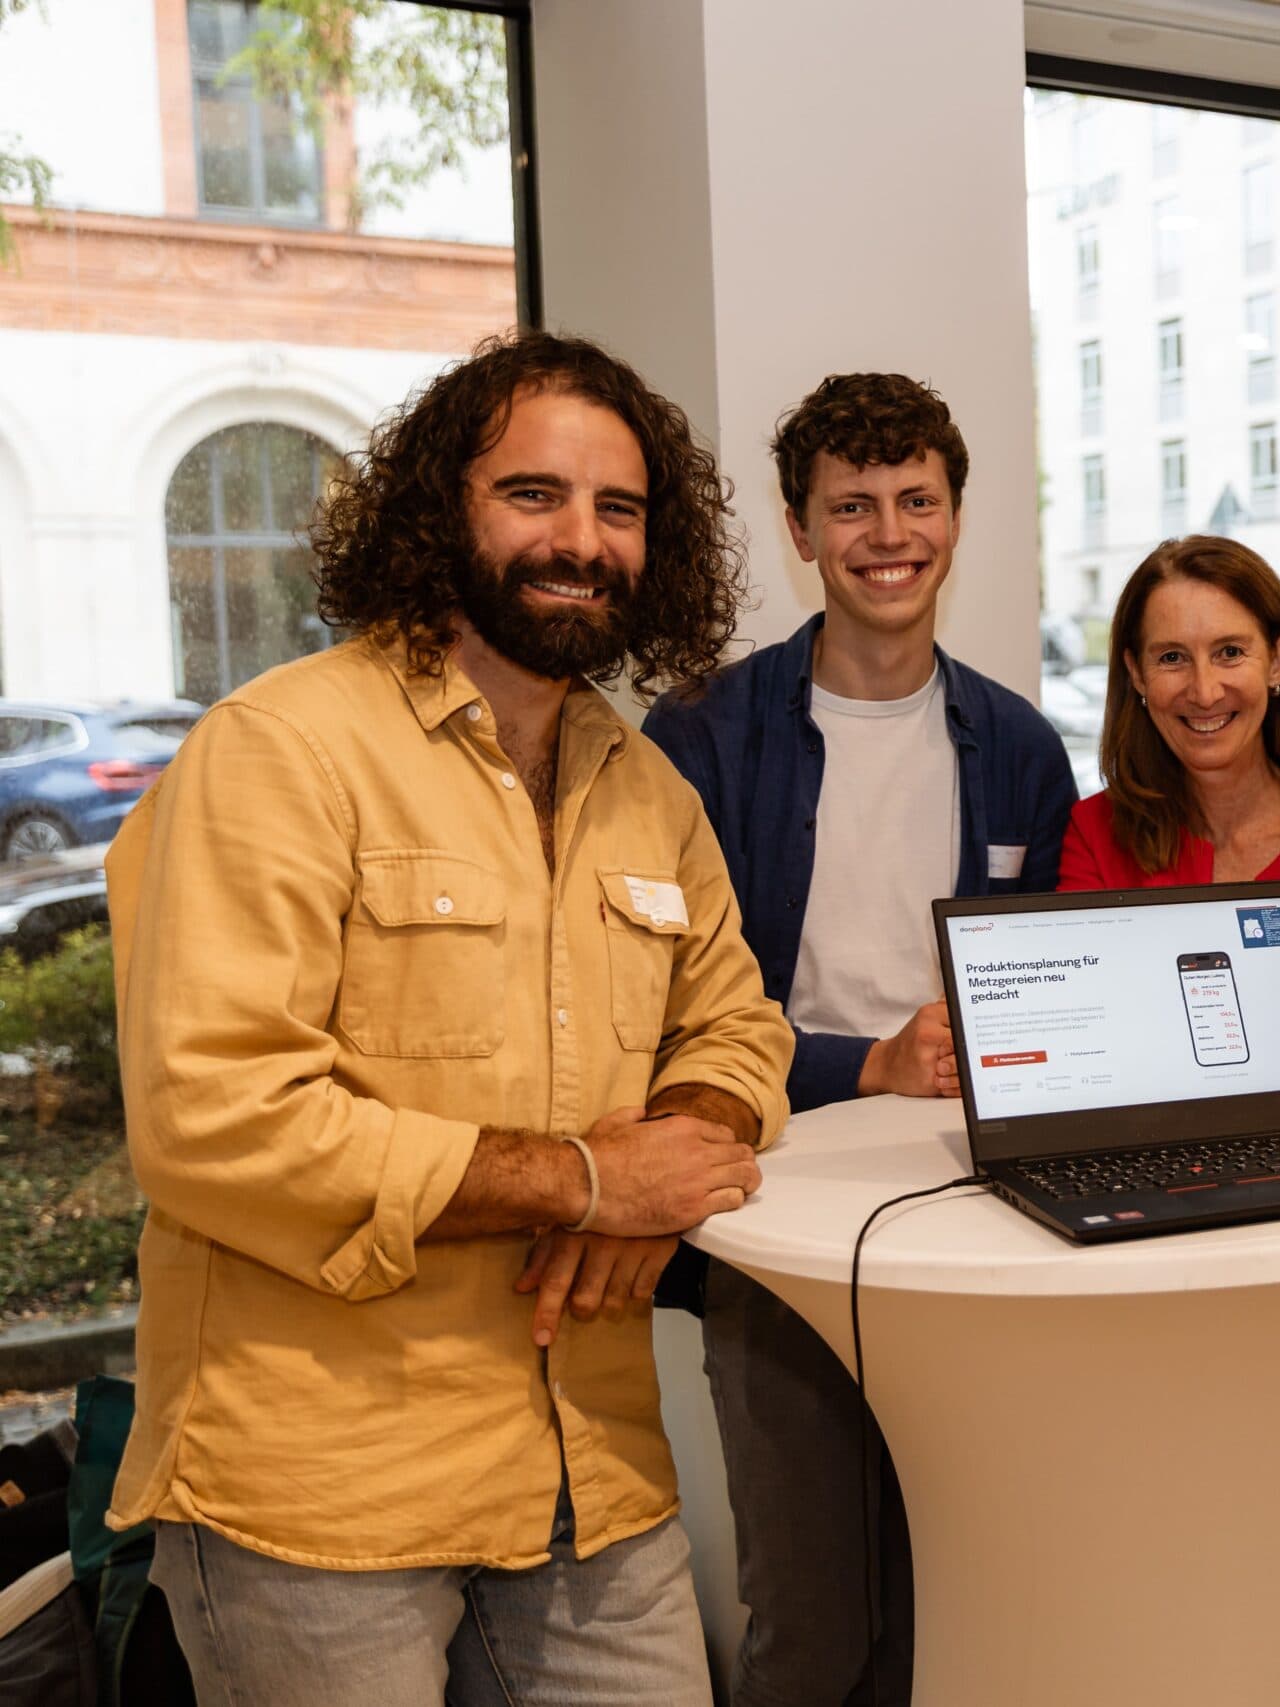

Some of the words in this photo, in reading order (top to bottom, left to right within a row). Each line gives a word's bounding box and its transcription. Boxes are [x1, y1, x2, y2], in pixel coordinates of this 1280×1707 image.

[959, 923, 994, 934] donplano
[965, 957, 1082, 974] Produktionsplanung
[1082, 954, 1100, 967] für
[968, 974, 1042, 989] Metzgereien
[1043, 973, 1066, 984] neu
[970, 988, 1020, 1005] gedacht
